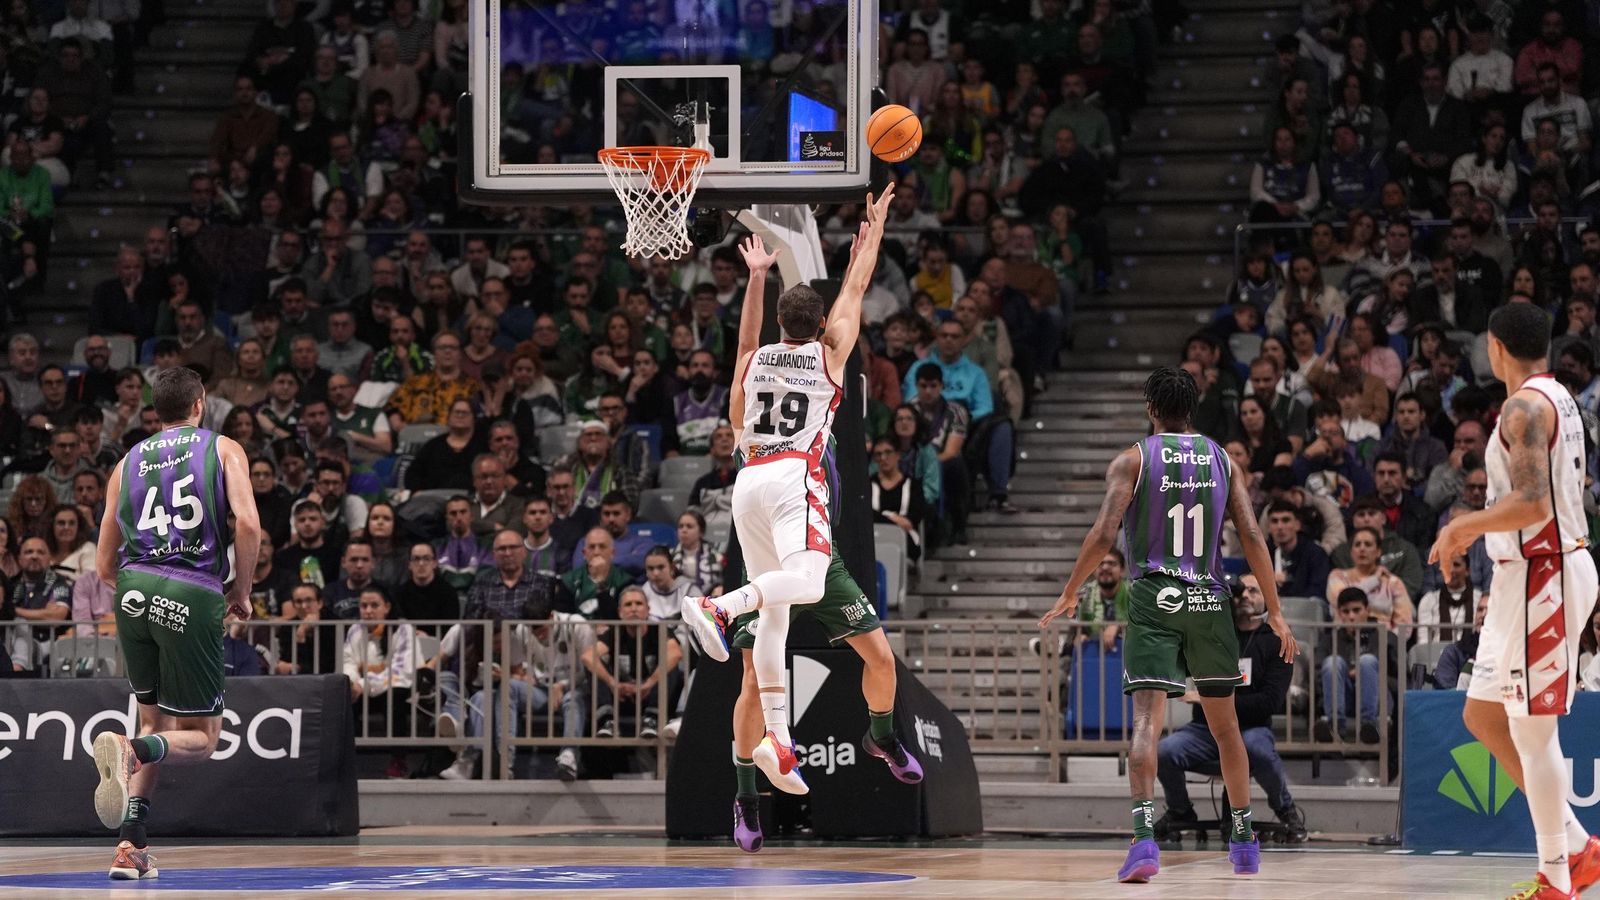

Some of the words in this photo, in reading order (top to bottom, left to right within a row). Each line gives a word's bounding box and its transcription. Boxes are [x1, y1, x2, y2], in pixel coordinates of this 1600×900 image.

[757, 352, 817, 370] SULEJMANOVIĆ
[753, 375, 766, 383] AIR
[753, 391, 810, 437] 19
[139, 433, 201, 453] Kravish
[1161, 447, 1213, 465] Carter
[136, 473, 204, 536] 45
[1167, 503, 1204, 558] 11
[1186, 586, 1213, 596] COS
[1187, 596, 1206, 604] DEL
[1207, 595, 1220, 603] SO
[150, 605, 167, 620] DEL
[167, 611, 188, 626] SOL
[151, 595, 190, 617] COSTA
[1188, 603, 1223, 612] MÁLAGA
[148, 613, 185, 634] MÁLAGA
